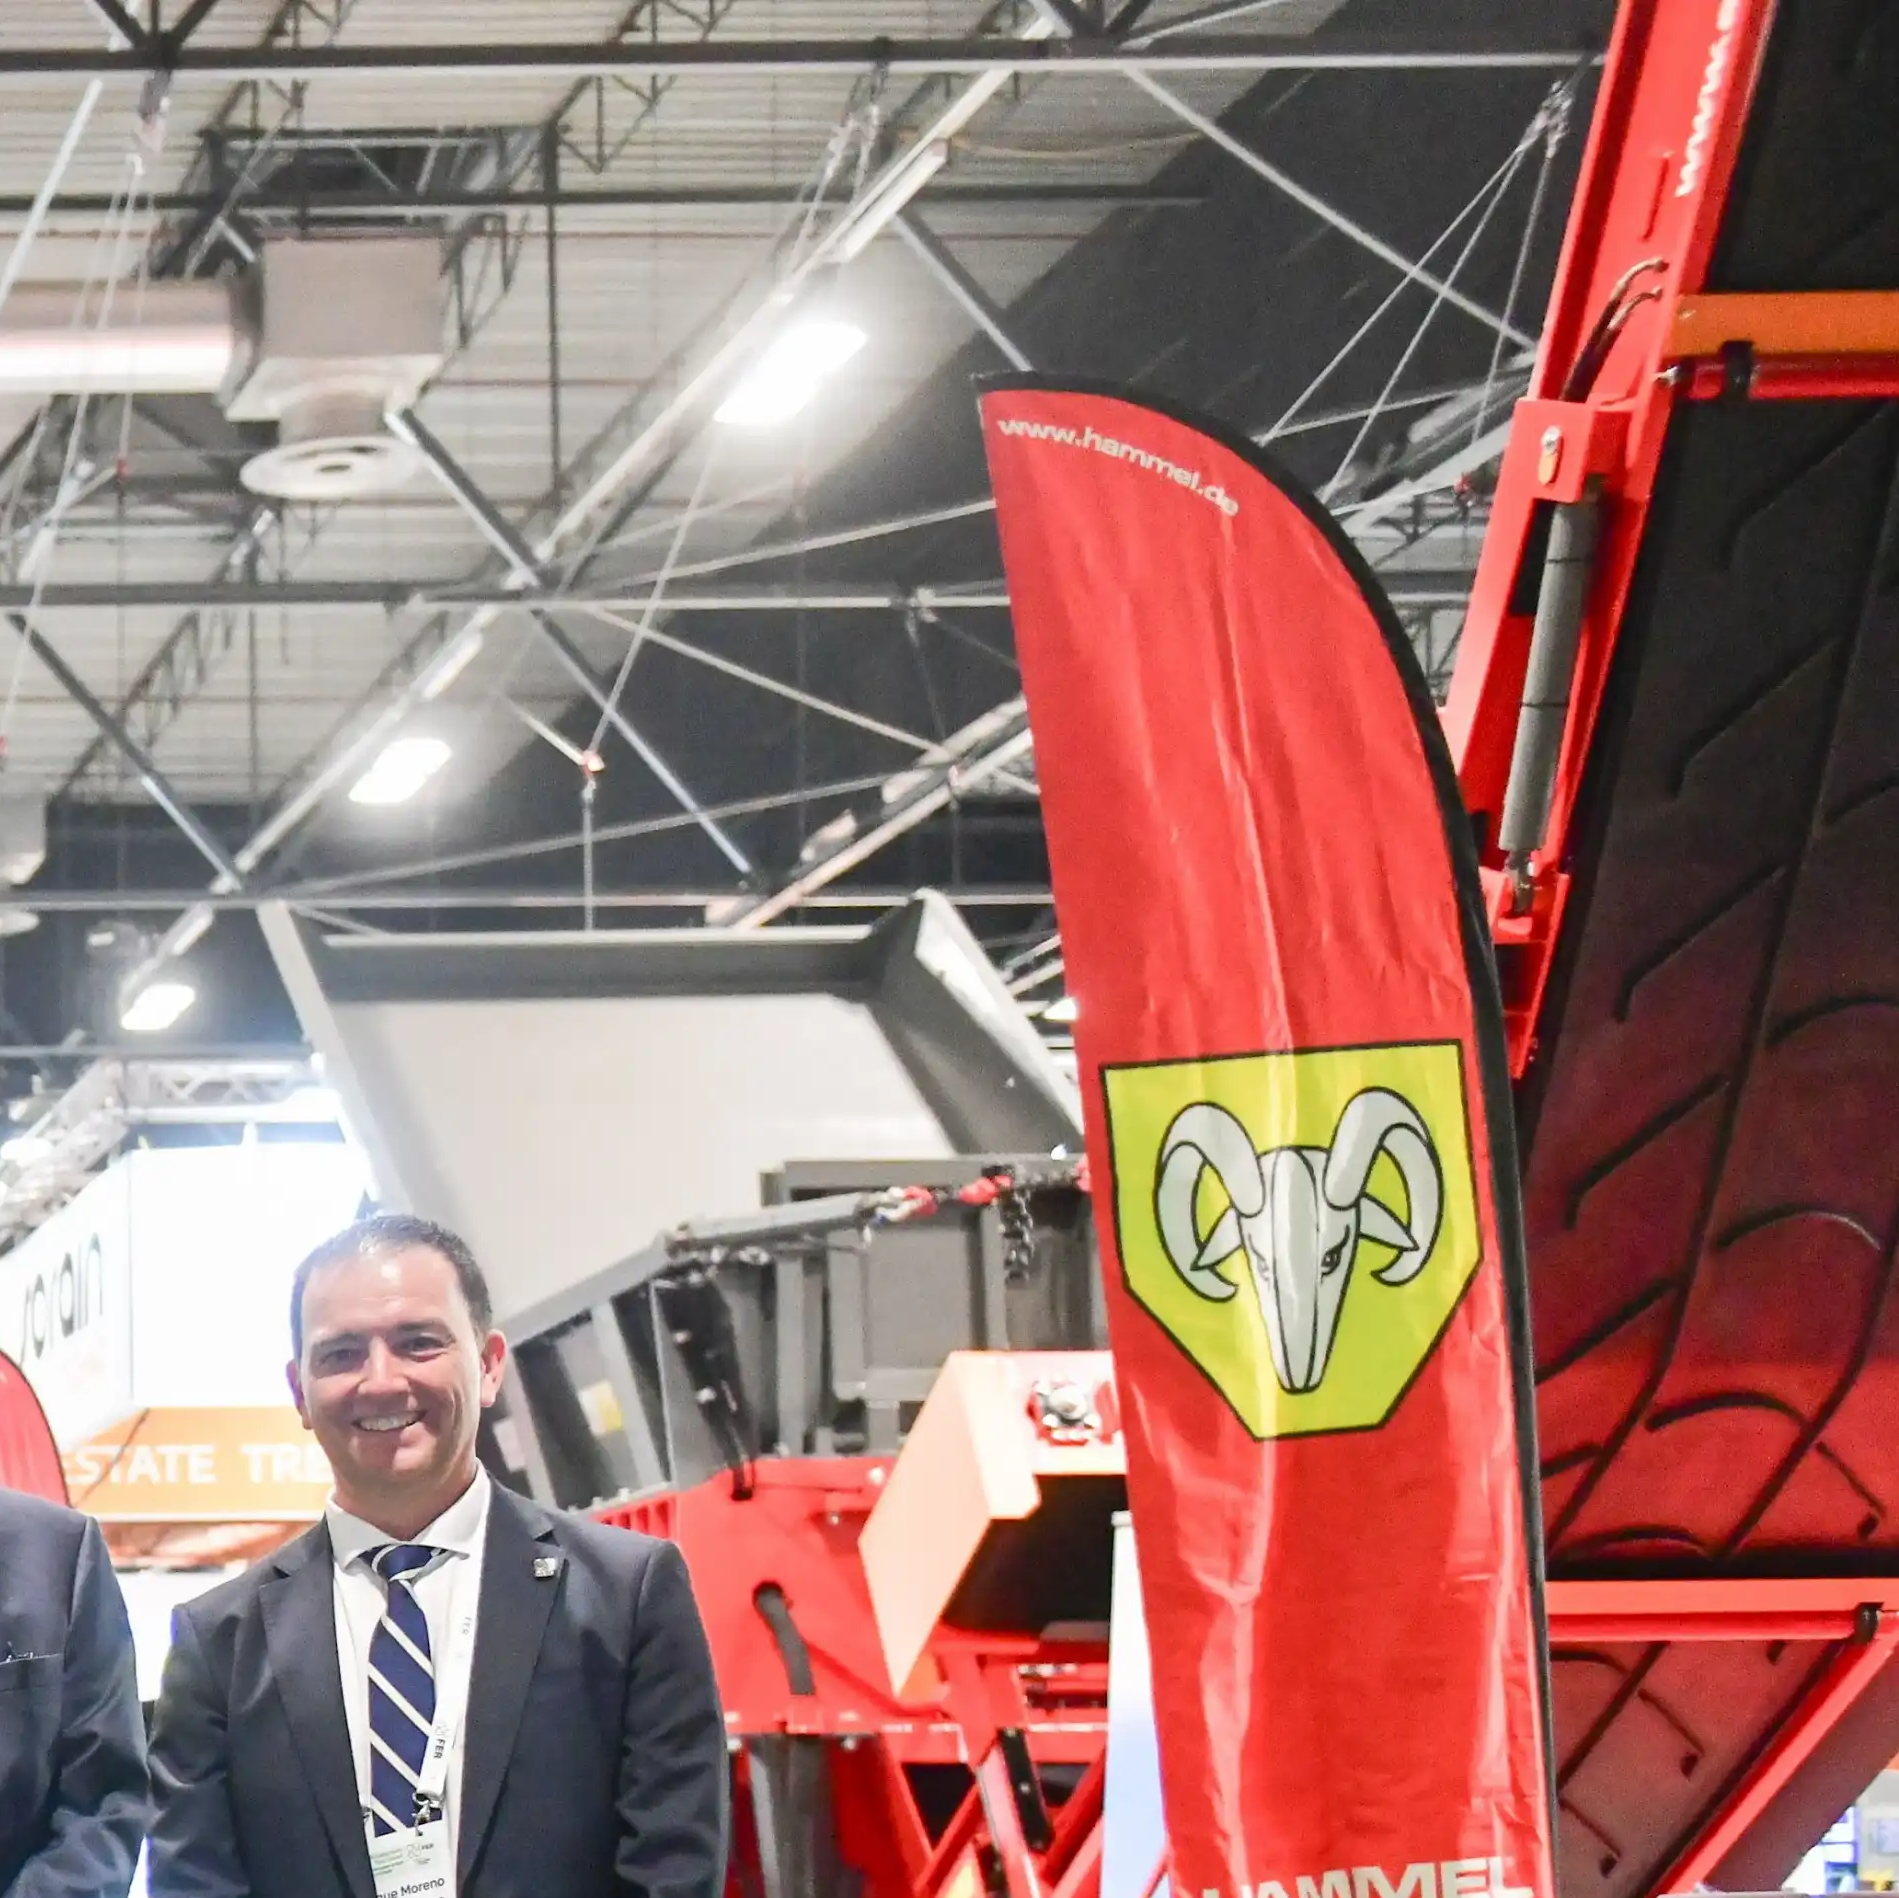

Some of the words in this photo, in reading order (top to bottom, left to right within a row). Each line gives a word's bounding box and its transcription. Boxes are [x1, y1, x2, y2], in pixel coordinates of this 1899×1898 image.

[997, 419, 1239, 516] www.hammel.de
[432, 1738, 446, 1760] FER
[400, 1877, 445, 1897] Moreno
